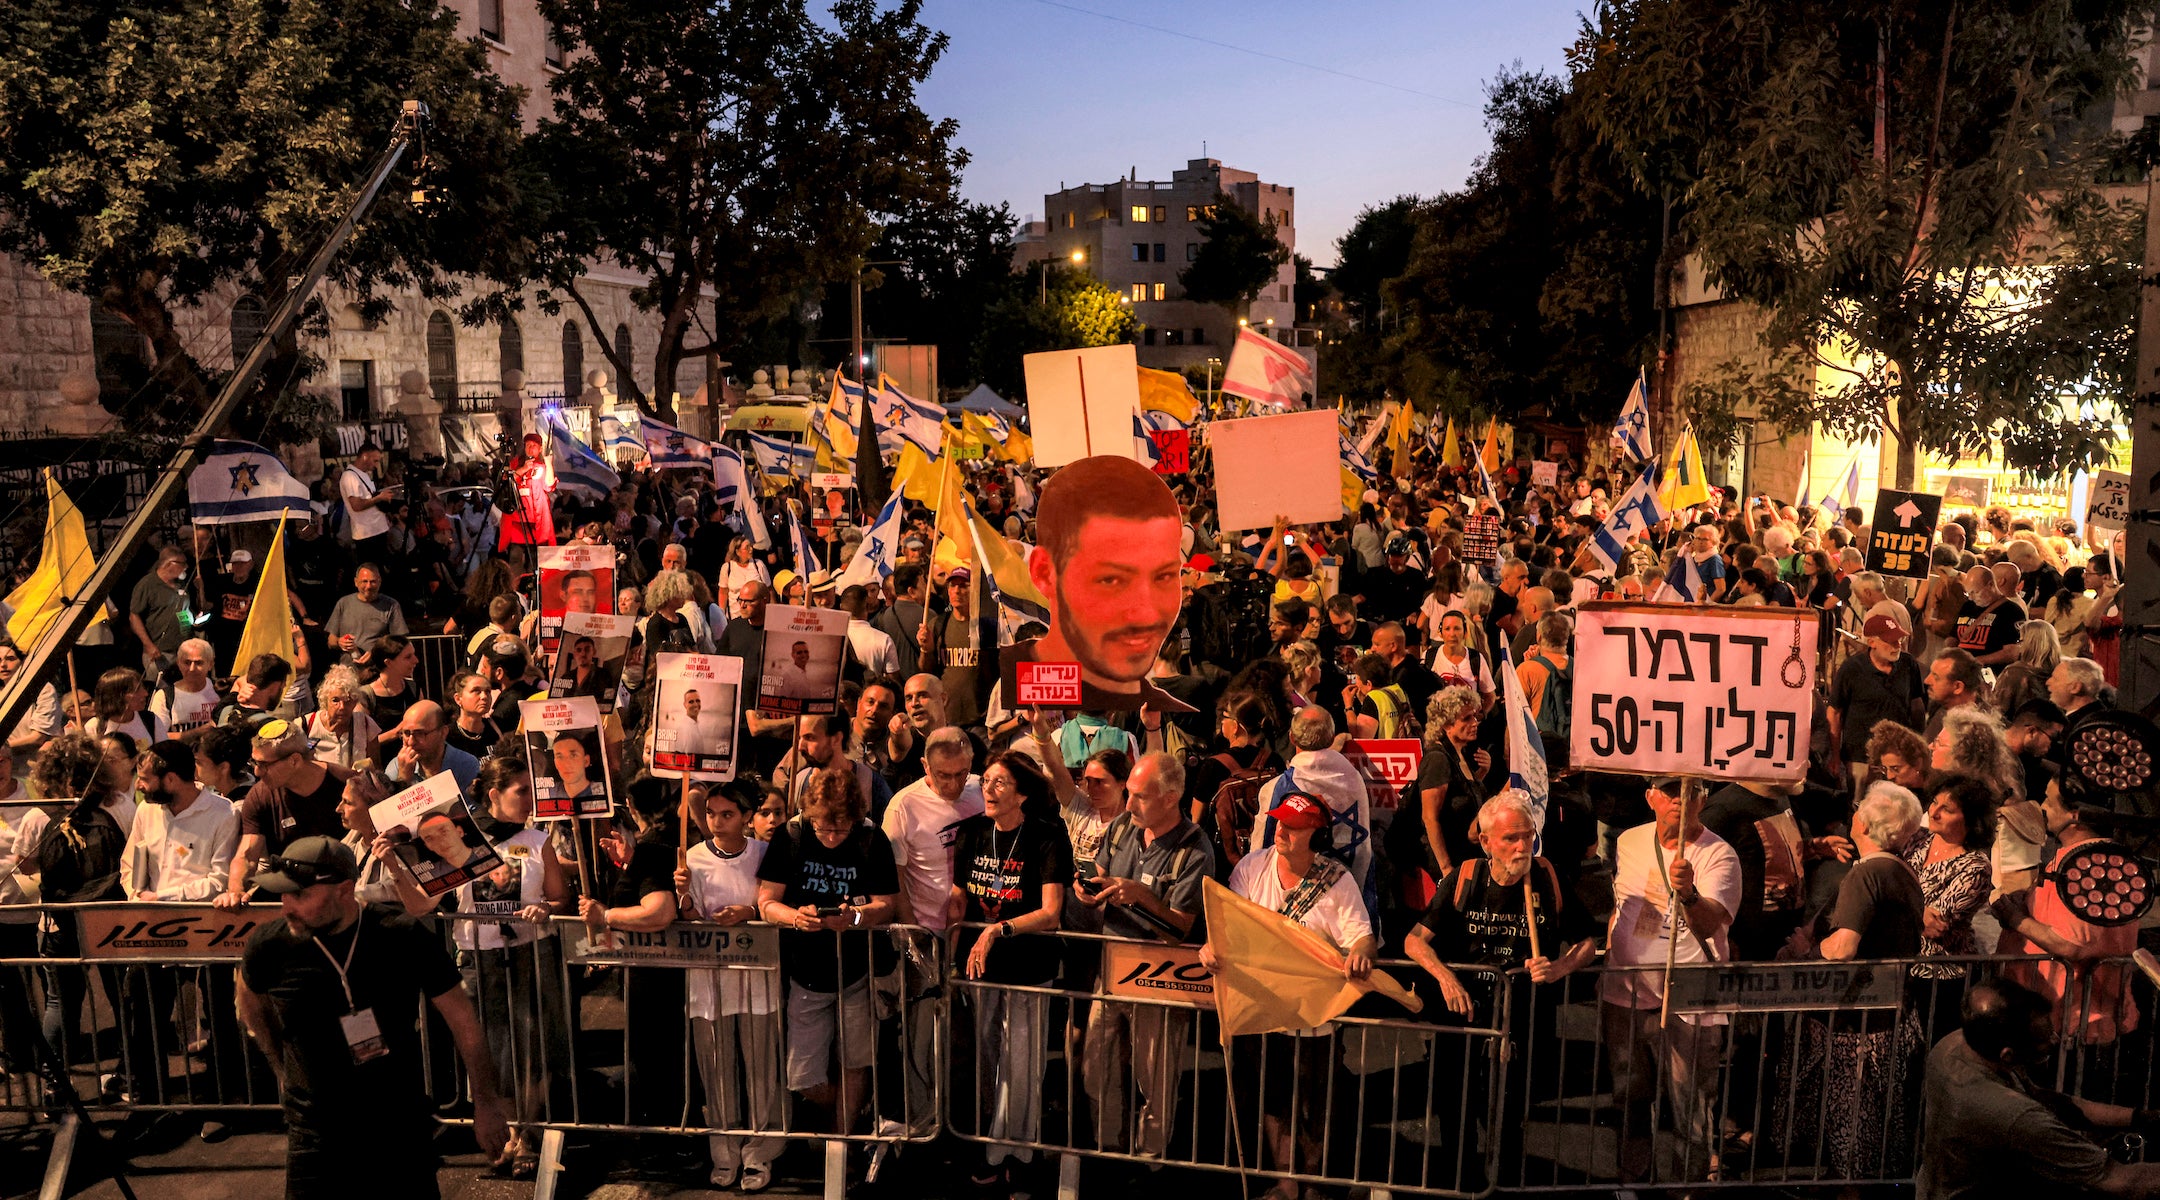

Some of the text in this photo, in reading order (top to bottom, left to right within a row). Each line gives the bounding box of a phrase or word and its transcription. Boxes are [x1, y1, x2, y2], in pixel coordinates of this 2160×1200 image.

[1150, 431, 1179, 448] TOP
[1151, 452, 1183, 471] AR!
[1875, 531, 1928, 552] לעזה
[1882, 552, 1911, 571] 35
[541, 616, 562, 627] BRING
[541, 627, 555, 637] HIM
[1603, 626, 1769, 686] דרמר
[762, 675, 784, 687] BRING
[1036, 667, 1076, 682] עדיין
[553, 678, 574, 689] BRING
[551, 688, 565, 698] HIM
[761, 686, 775, 695] HIM
[1027, 686, 1077, 699] בעזה.
[1590, 693, 1683, 757] ה-50
[657, 728, 677, 741] BRING
[656, 740, 669, 752] HIM
[536, 777, 555, 788] BRING
[537, 788, 551, 799] HIM
[411, 860, 435, 875] BRING
[974, 855, 1000, 870] שלנו
[417, 872, 434, 884] HIM
[971, 870, 995, 884] בעזה
[476, 904, 495, 914] BRING
[1469, 923, 1516, 936] הכיפורים
[678, 930, 730, 952] קשת
[1137, 979, 1211, 992] 054-5559900
[1793, 970, 1850, 993] קשת
